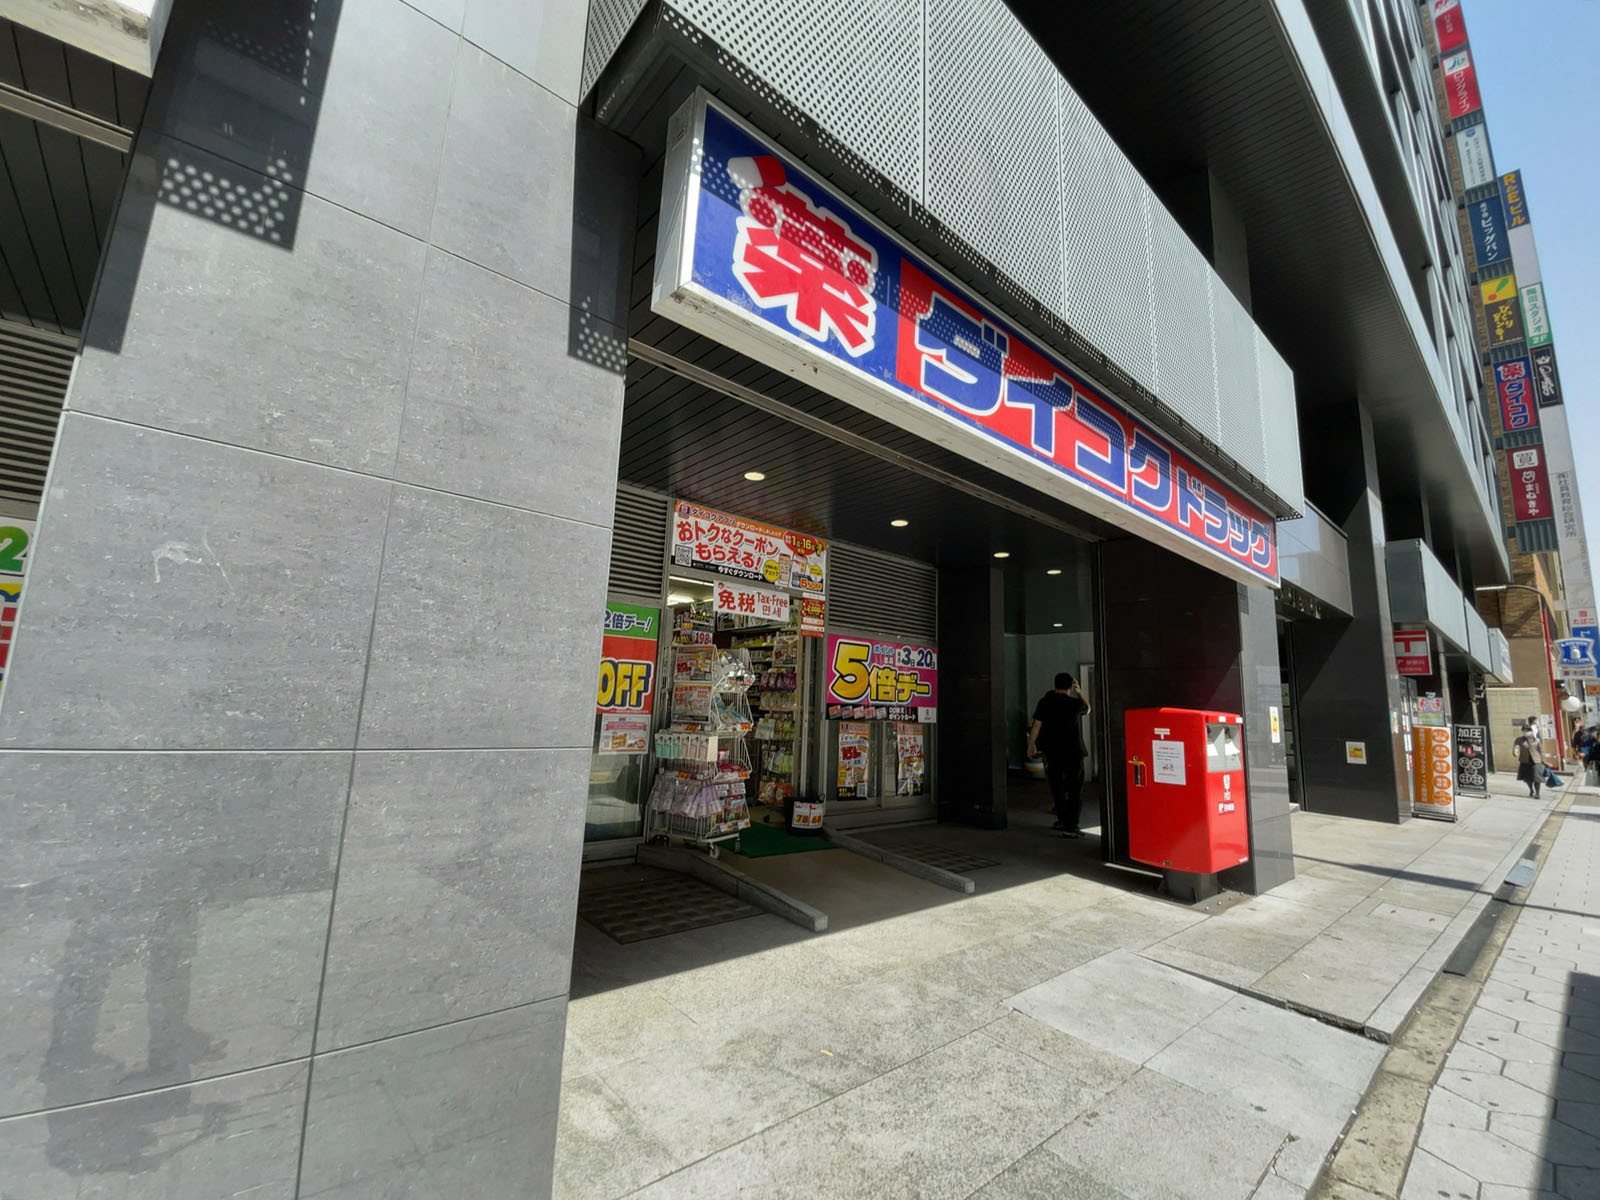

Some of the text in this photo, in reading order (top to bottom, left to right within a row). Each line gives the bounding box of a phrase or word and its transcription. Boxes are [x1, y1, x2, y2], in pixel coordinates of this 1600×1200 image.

[730, 156, 1273, 568] 薬 ダイコクドラッグ
[1505, 381, 1530, 428] ダイコク
[676, 520, 780, 557] おトクなクーポン
[694, 541, 762, 571] もらえる!
[718, 566, 764, 581] 今すぐダウンロード
[717, 589, 756, 614] 免税
[757, 592, 788, 609] Tax-Free
[597, 659, 650, 709] OFF
[831, 640, 930, 703] 5倍デー
[1457, 728, 1482, 738] 加圧
